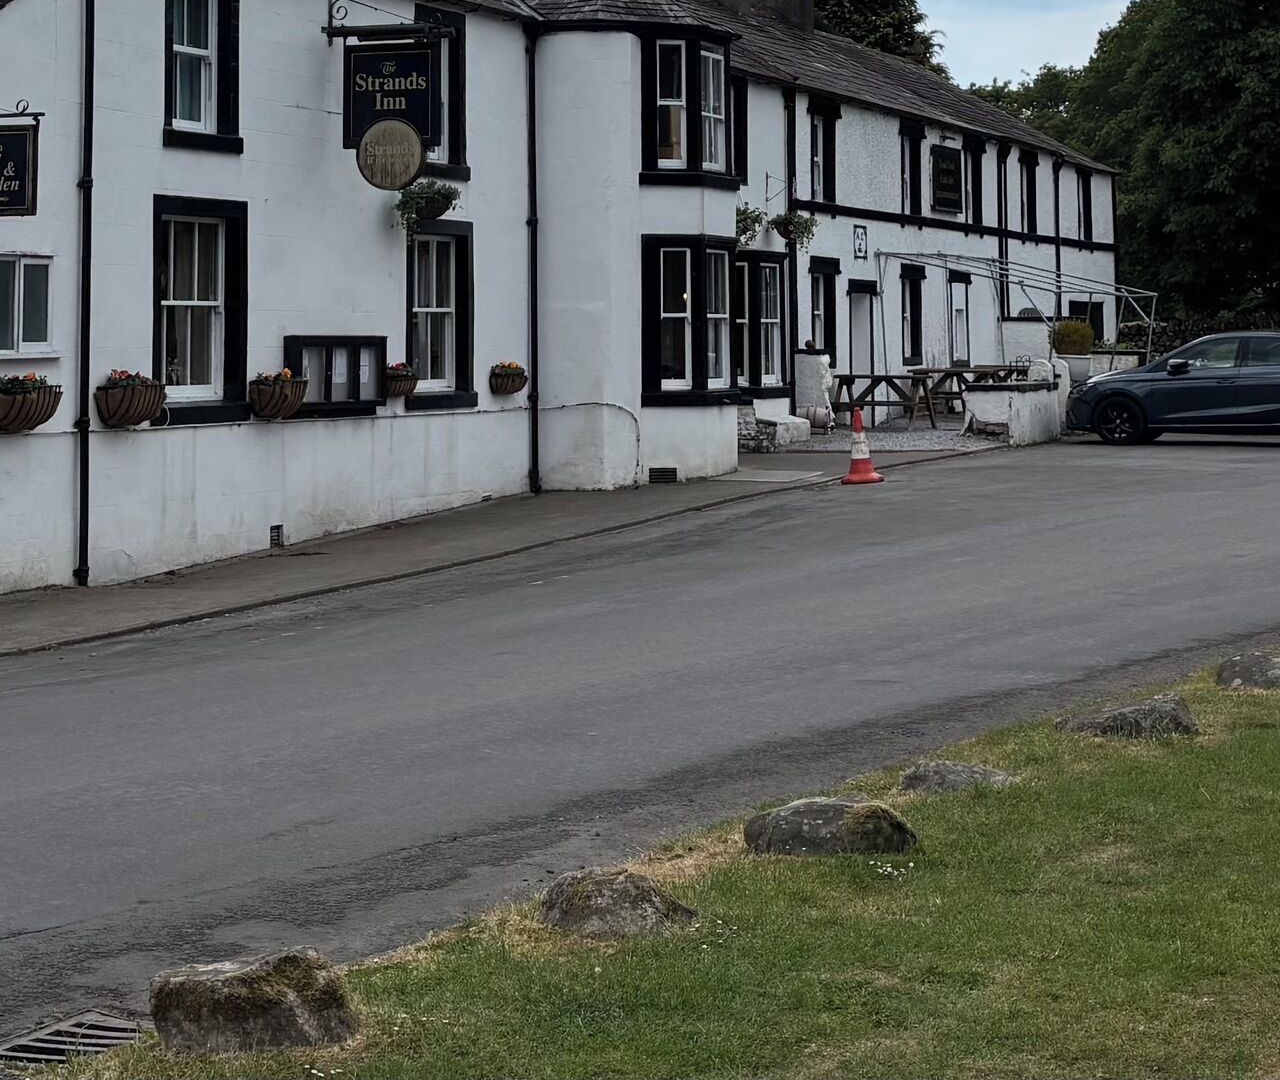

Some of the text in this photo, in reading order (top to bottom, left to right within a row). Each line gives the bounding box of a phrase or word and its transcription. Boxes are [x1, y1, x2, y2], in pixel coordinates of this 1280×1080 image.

[380, 61, 397, 75] The
[355, 72, 427, 92] Strands
[374, 92, 407, 110] Inn
[366, 141, 415, 156] Strands
[3, 161, 16, 176] &
